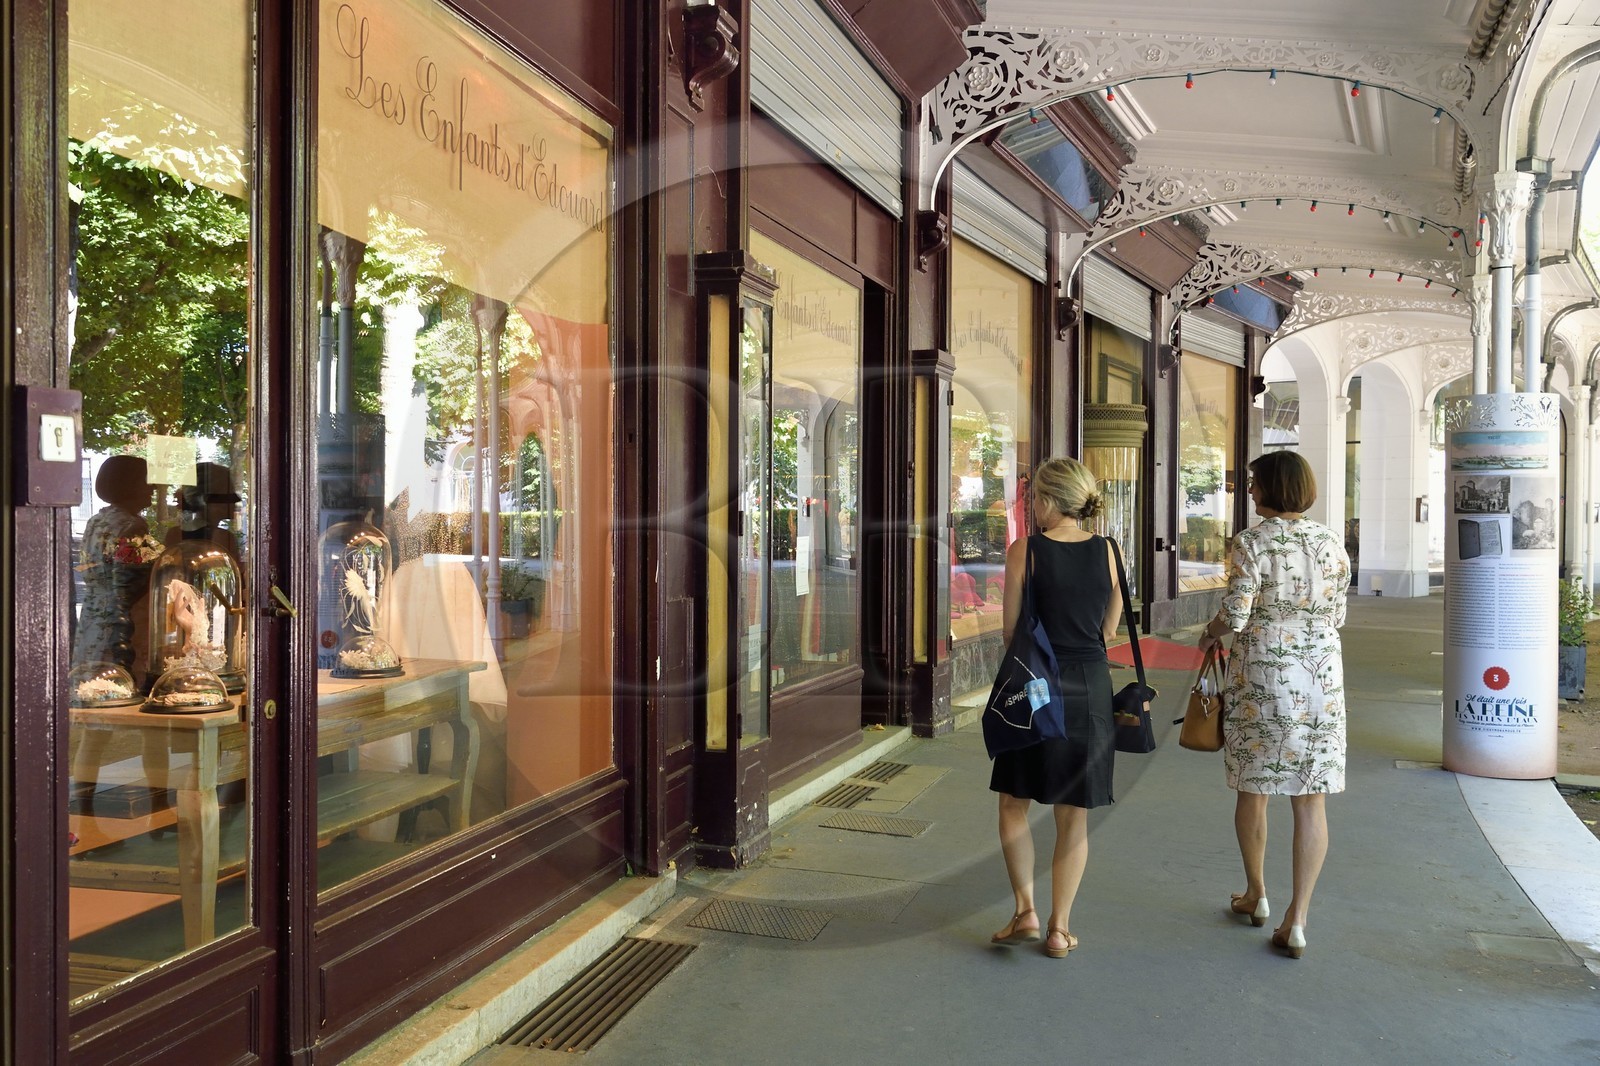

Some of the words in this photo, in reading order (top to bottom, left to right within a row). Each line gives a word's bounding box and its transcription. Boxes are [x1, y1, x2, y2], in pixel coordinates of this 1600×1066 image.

[336, 3, 406, 126] Les
[416, 55, 511, 191] Enfants
[1455, 700, 1475, 714] LA
[1482, 703, 1538, 717] REINE
[1477, 695, 1495, 704] était
[1510, 697, 1527, 706] fois
